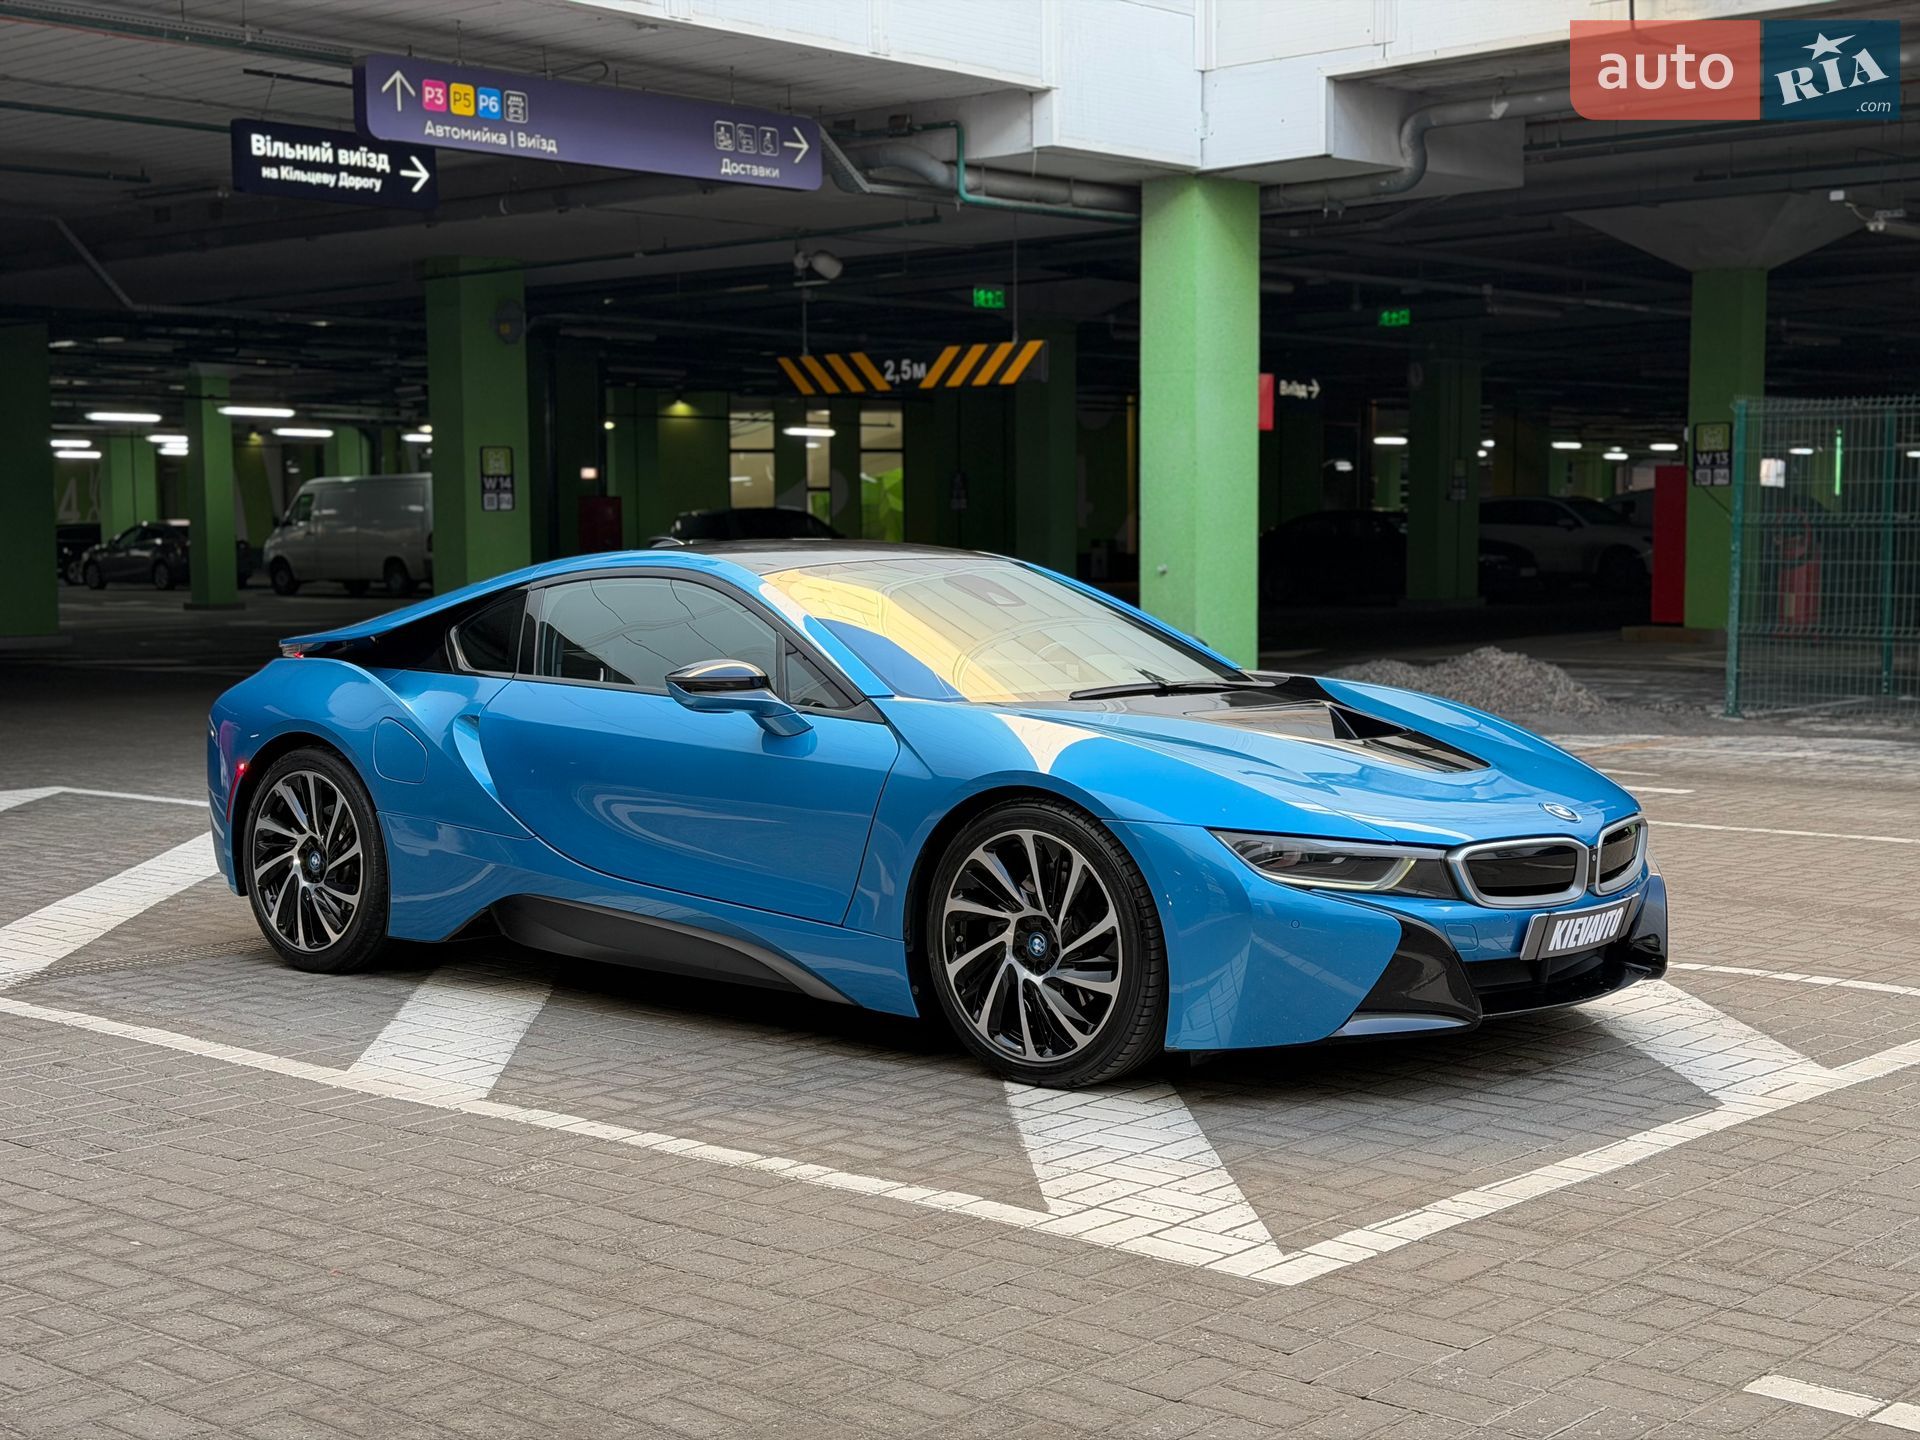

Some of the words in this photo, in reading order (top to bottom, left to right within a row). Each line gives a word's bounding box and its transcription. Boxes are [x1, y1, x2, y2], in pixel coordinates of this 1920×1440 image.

[424, 86, 444, 105] P3
[453, 91, 472, 108] P5
[479, 94, 499, 113] P6
[424, 120, 507, 146] Автомийка
[517, 132, 557, 154] Виїзд
[250, 133, 334, 164] Вільний
[337, 147, 391, 173] виїзд
[261, 166, 280, 180] на
[280, 165, 337, 188] Кільцеву
[338, 171, 383, 193] Дорогу
[721, 157, 780, 178] Доставки
